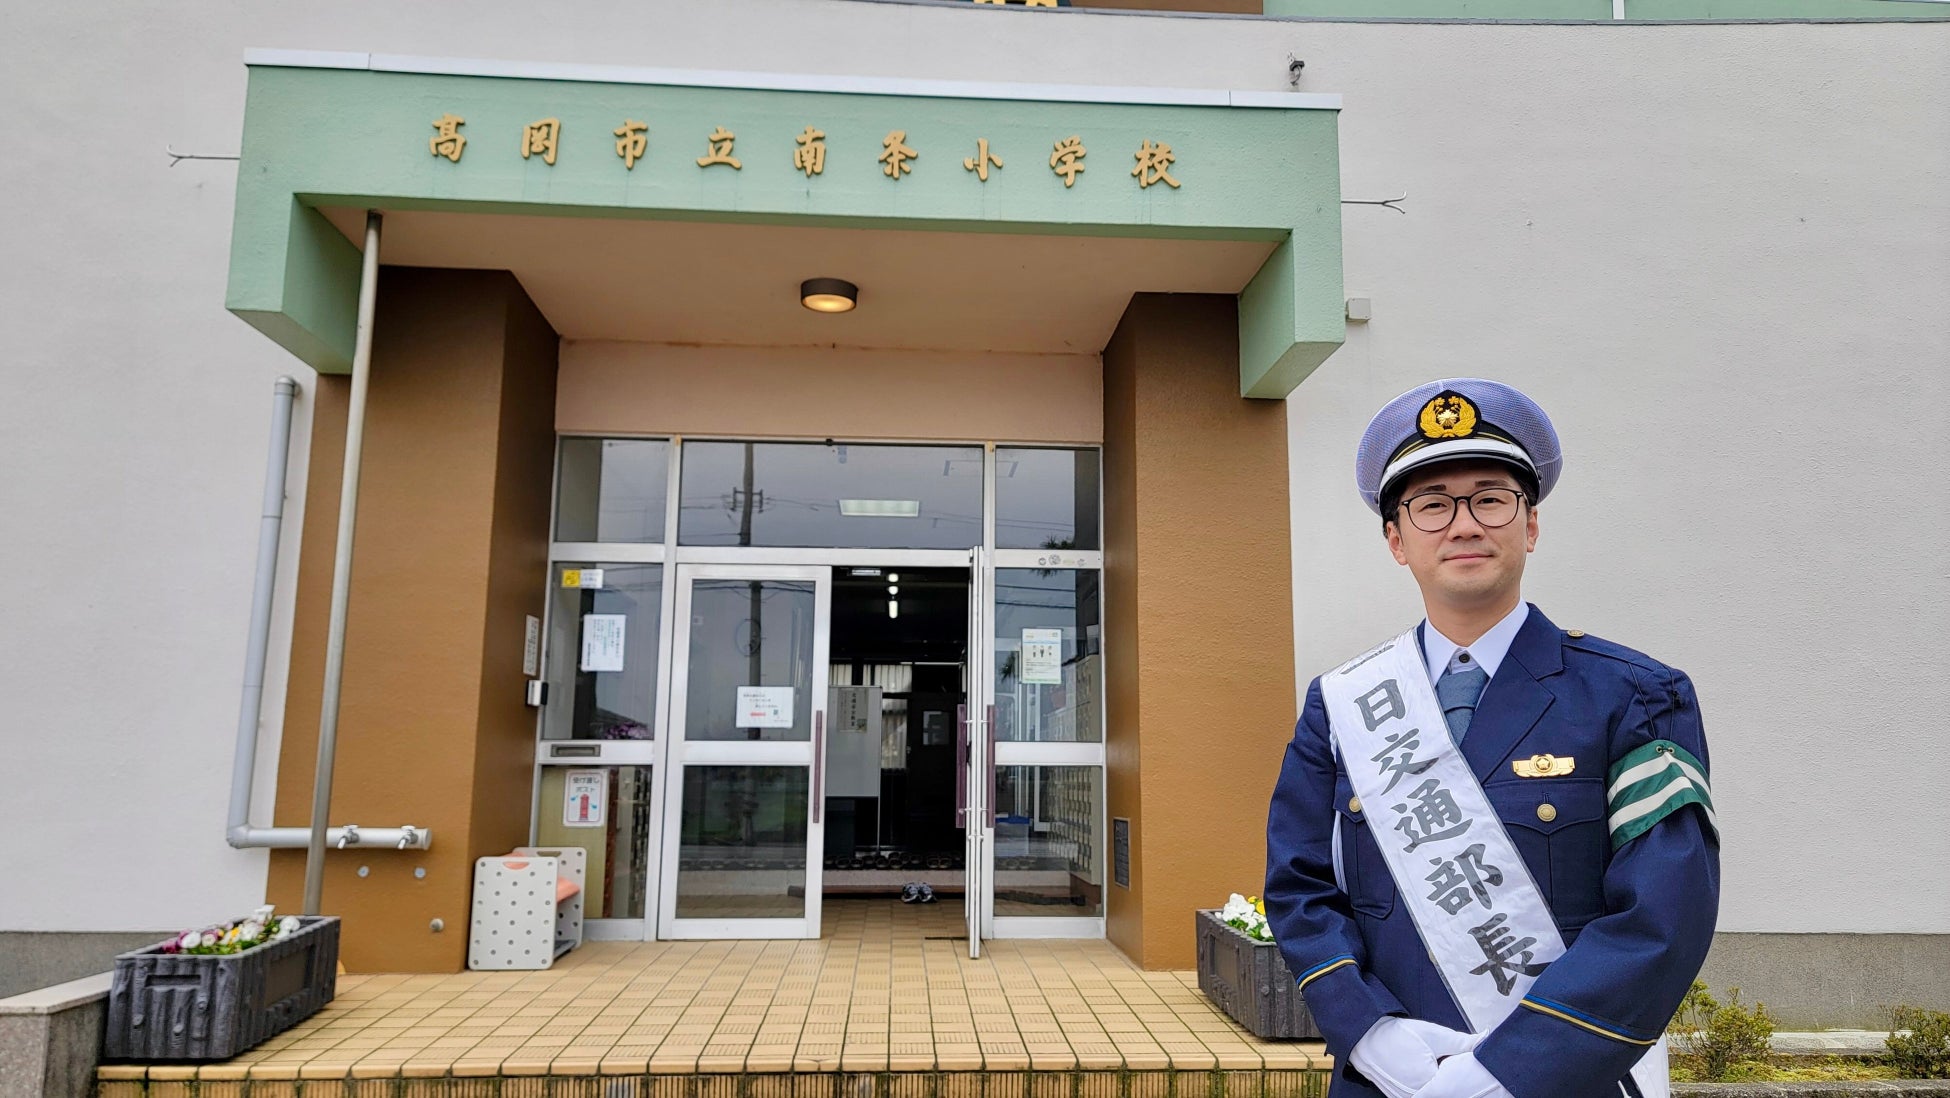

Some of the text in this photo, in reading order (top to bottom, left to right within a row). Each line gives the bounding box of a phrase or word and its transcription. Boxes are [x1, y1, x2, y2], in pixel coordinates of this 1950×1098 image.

[1340, 644, 1553, 998] 一日交通部長
